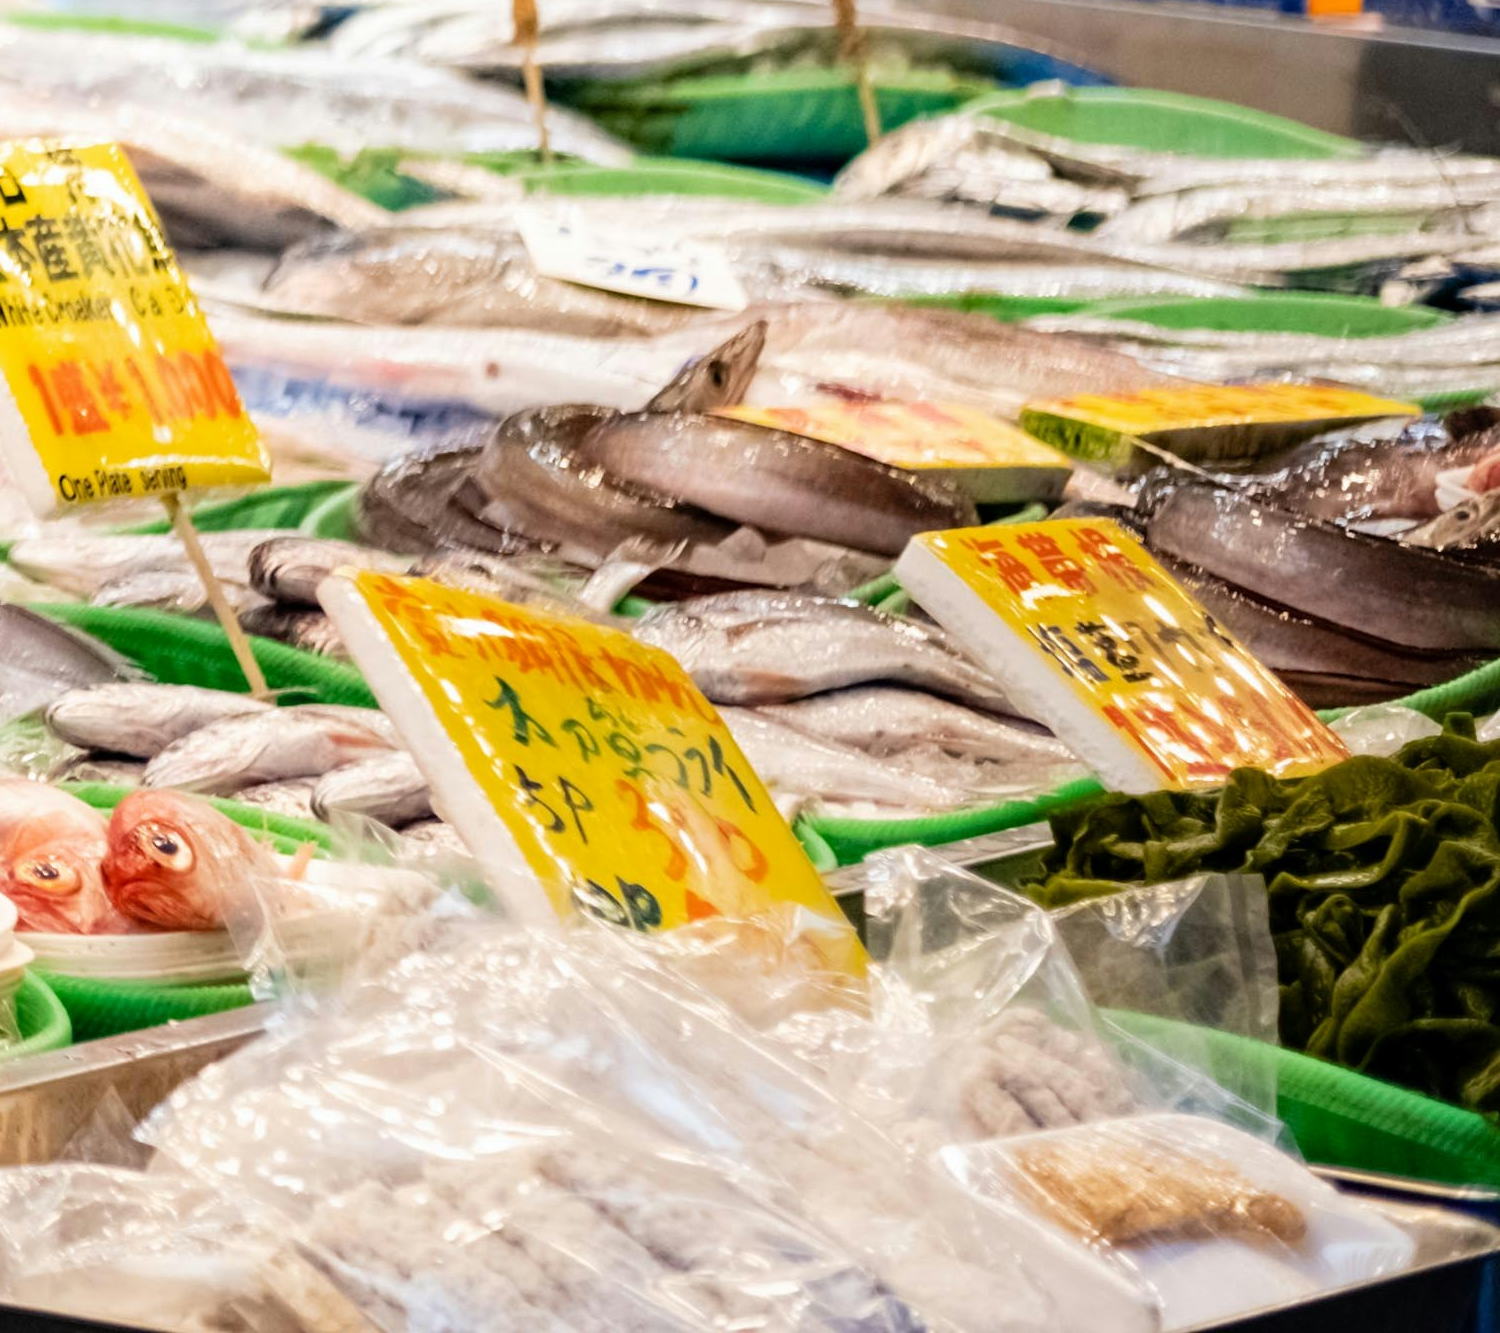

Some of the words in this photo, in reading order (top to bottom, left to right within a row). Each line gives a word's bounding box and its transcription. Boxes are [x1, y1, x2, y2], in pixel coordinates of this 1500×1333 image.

[57, 473, 95, 503] One
[97, 469, 136, 496] Plate
[139, 465, 188, 492] serving
